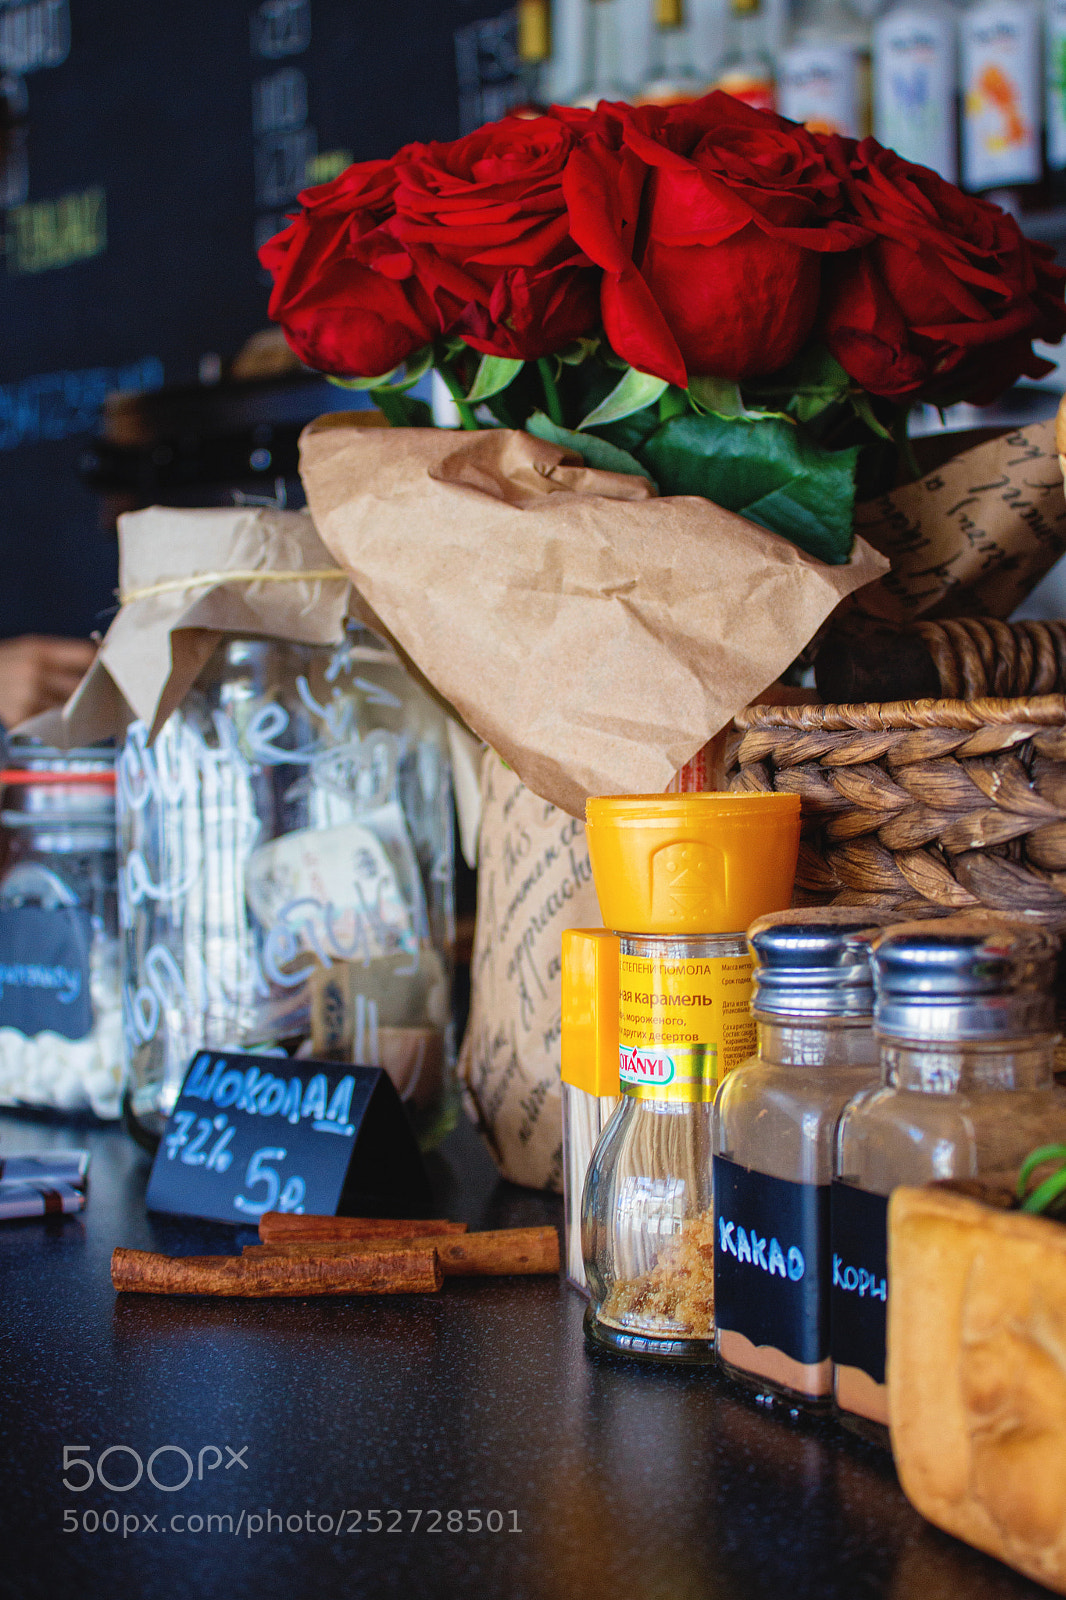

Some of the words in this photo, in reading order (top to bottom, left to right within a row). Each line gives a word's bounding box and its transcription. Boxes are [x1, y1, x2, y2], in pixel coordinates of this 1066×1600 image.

[622, 960, 657, 975] СТЕПЕНИ
[660, 964, 711, 977] ПОМОЛА
[634, 991, 713, 1009] карамель
[626, 1013, 687, 1027] мороженого,
[623, 1027, 647, 1040] других
[648, 1030, 699, 1044] десертов
[166, 1109, 237, 1174] 72%
[718, 1215, 806, 1282] КАКАО
